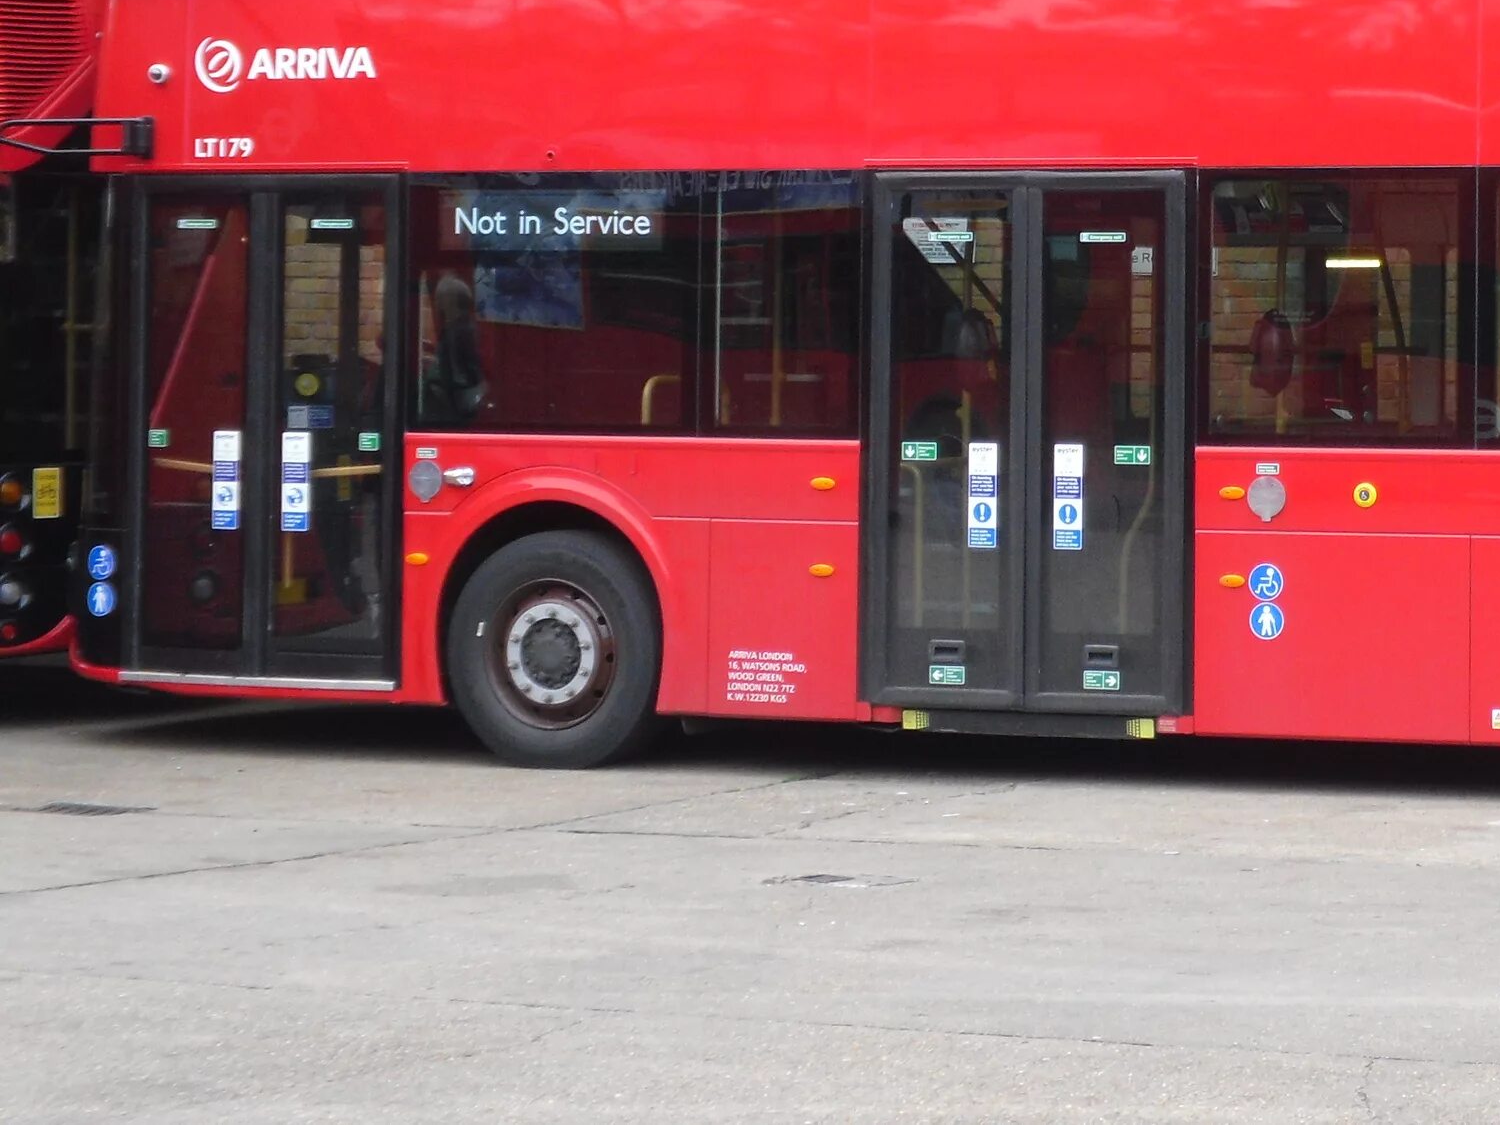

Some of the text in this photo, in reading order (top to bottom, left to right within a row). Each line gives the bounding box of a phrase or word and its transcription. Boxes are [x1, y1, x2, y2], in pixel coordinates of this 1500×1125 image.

[247, 47, 376, 80] ARRIVA
[194, 137, 255, 159] LT179
[454, 206, 651, 235] Not in Service
[728, 650, 793, 661] ARRIVA LONDON
[728, 662, 807, 674] 16, WATSONS ROAD,
[728, 672, 784, 683] WOOD GREEN,
[727, 682, 796, 694] LONDON N22 7TZ
[770, 694, 787, 704] KGS
